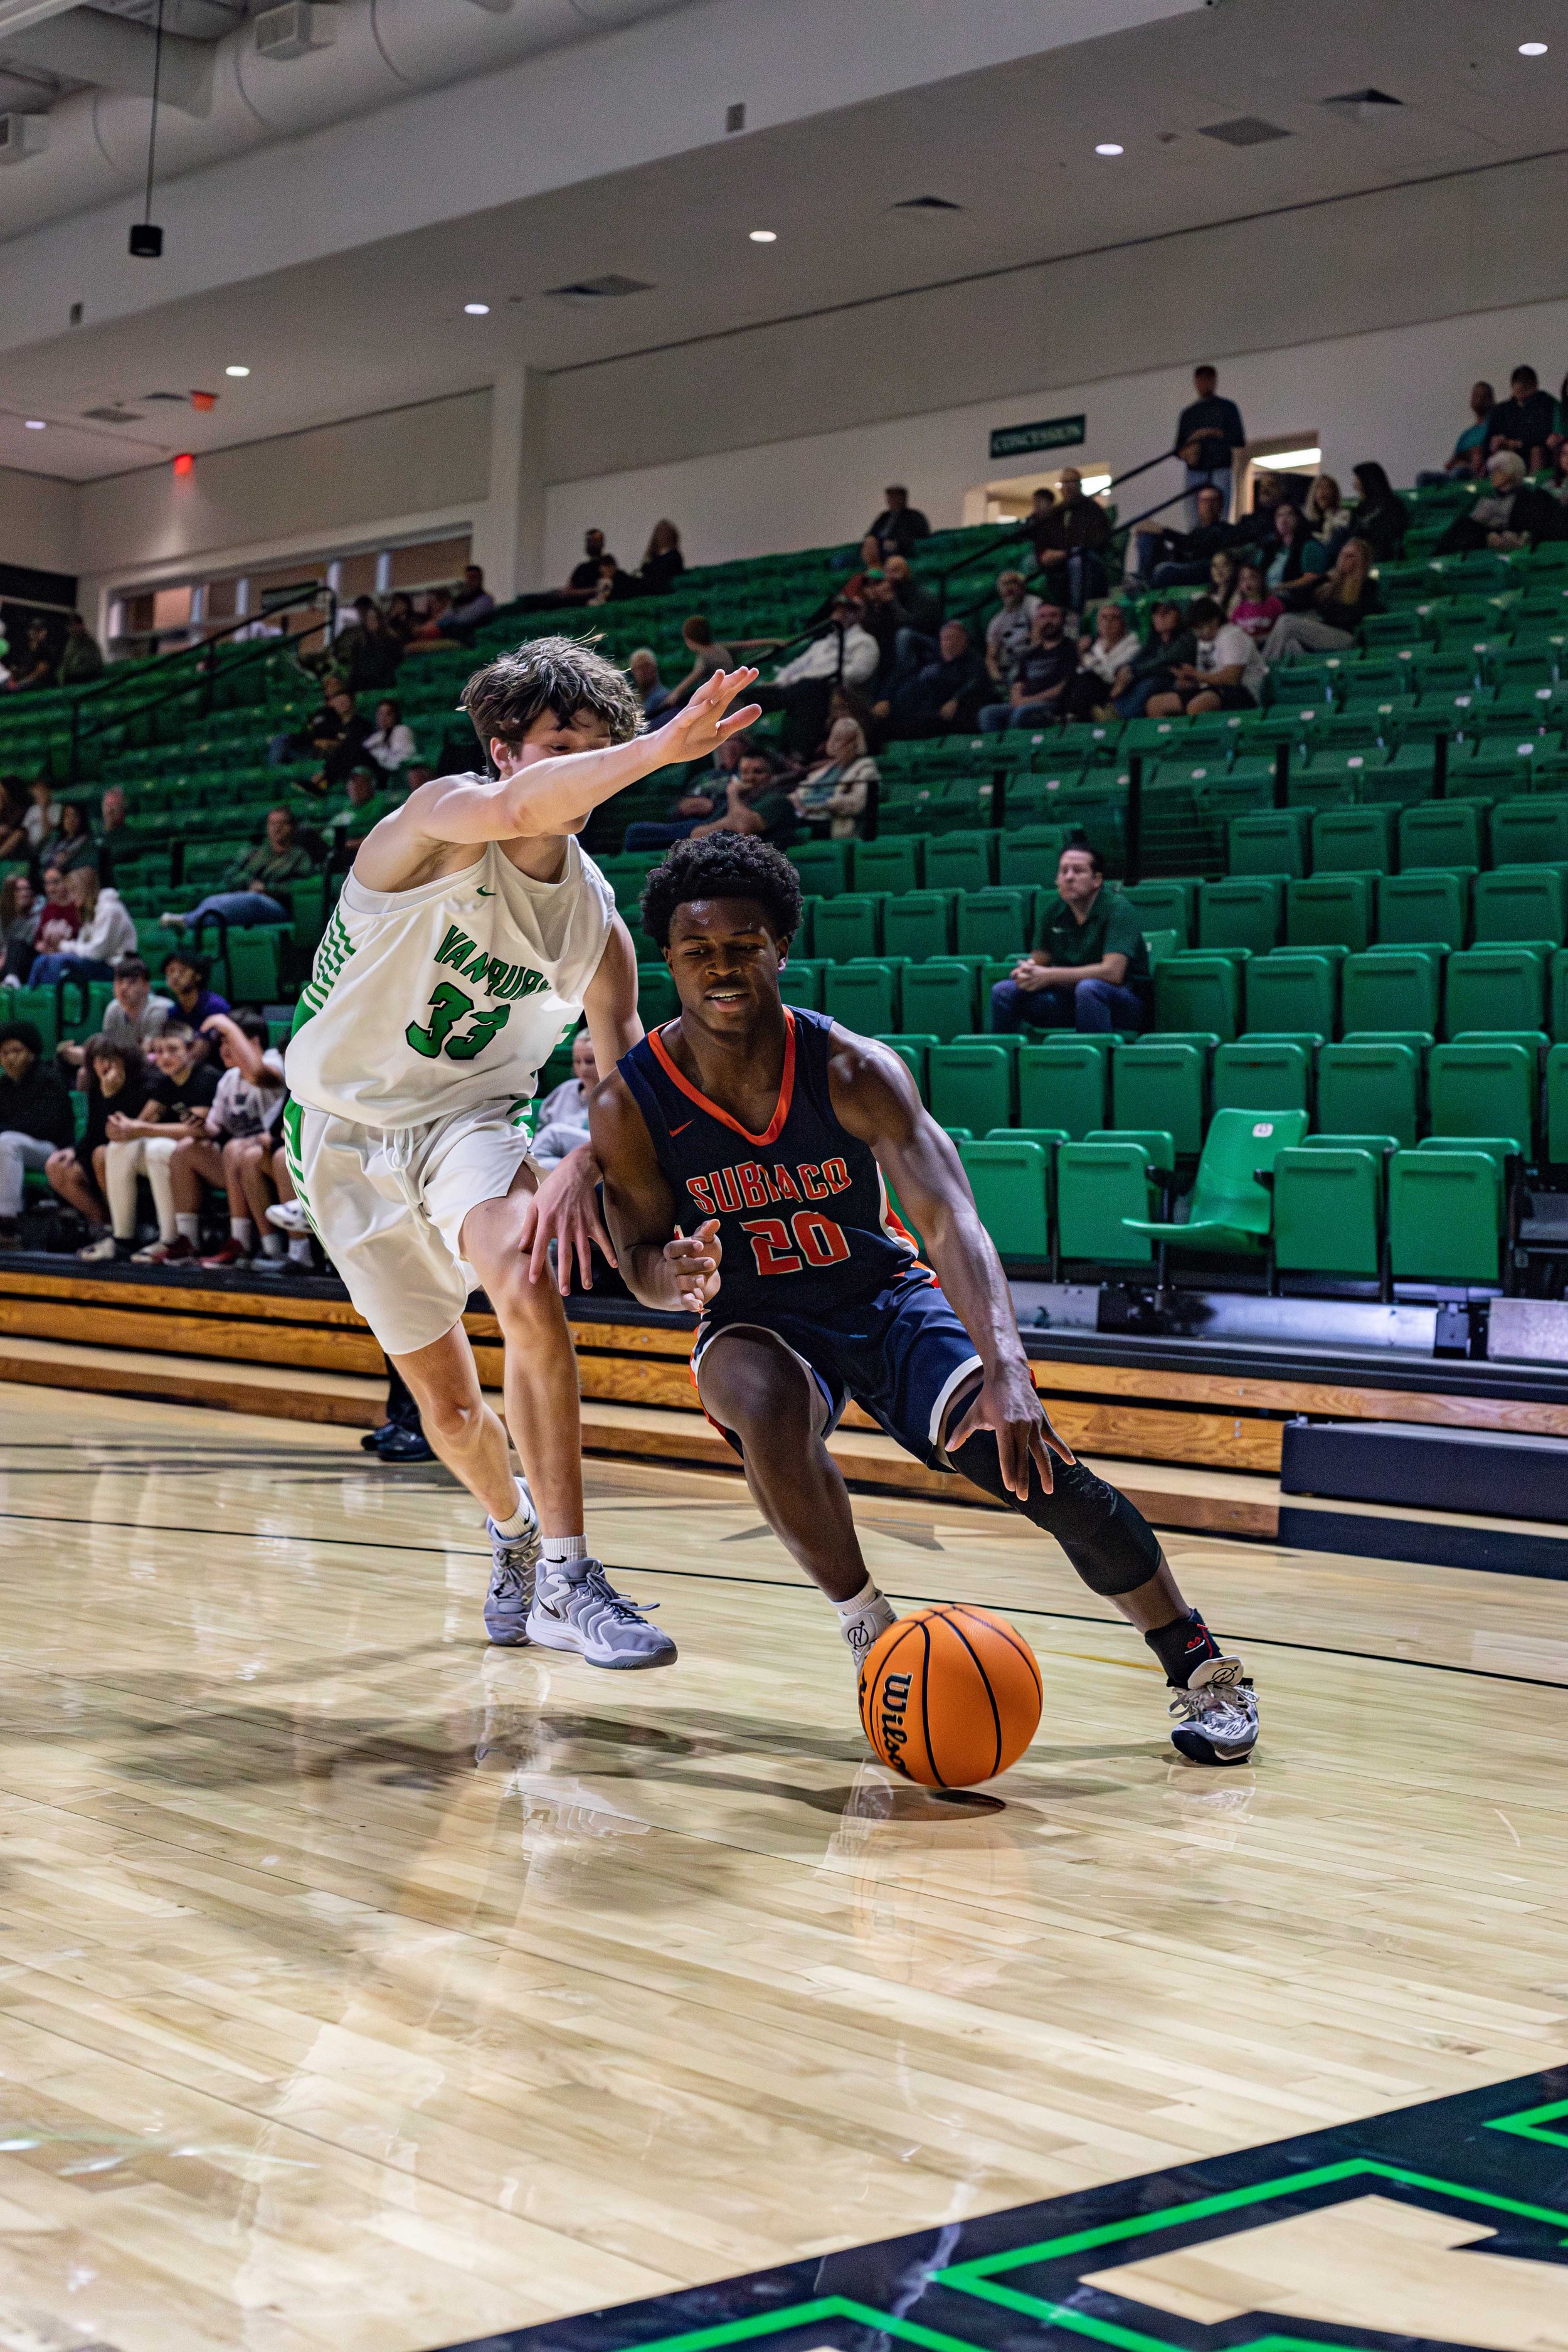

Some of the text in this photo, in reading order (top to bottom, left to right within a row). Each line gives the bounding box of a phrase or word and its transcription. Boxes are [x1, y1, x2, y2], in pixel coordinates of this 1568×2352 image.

[405, 981, 511, 1060] 33
[686, 1157, 852, 1214] SUBIACO
[739, 1210, 850, 1276] 20
[881, 1671, 914, 1780] Wilso
